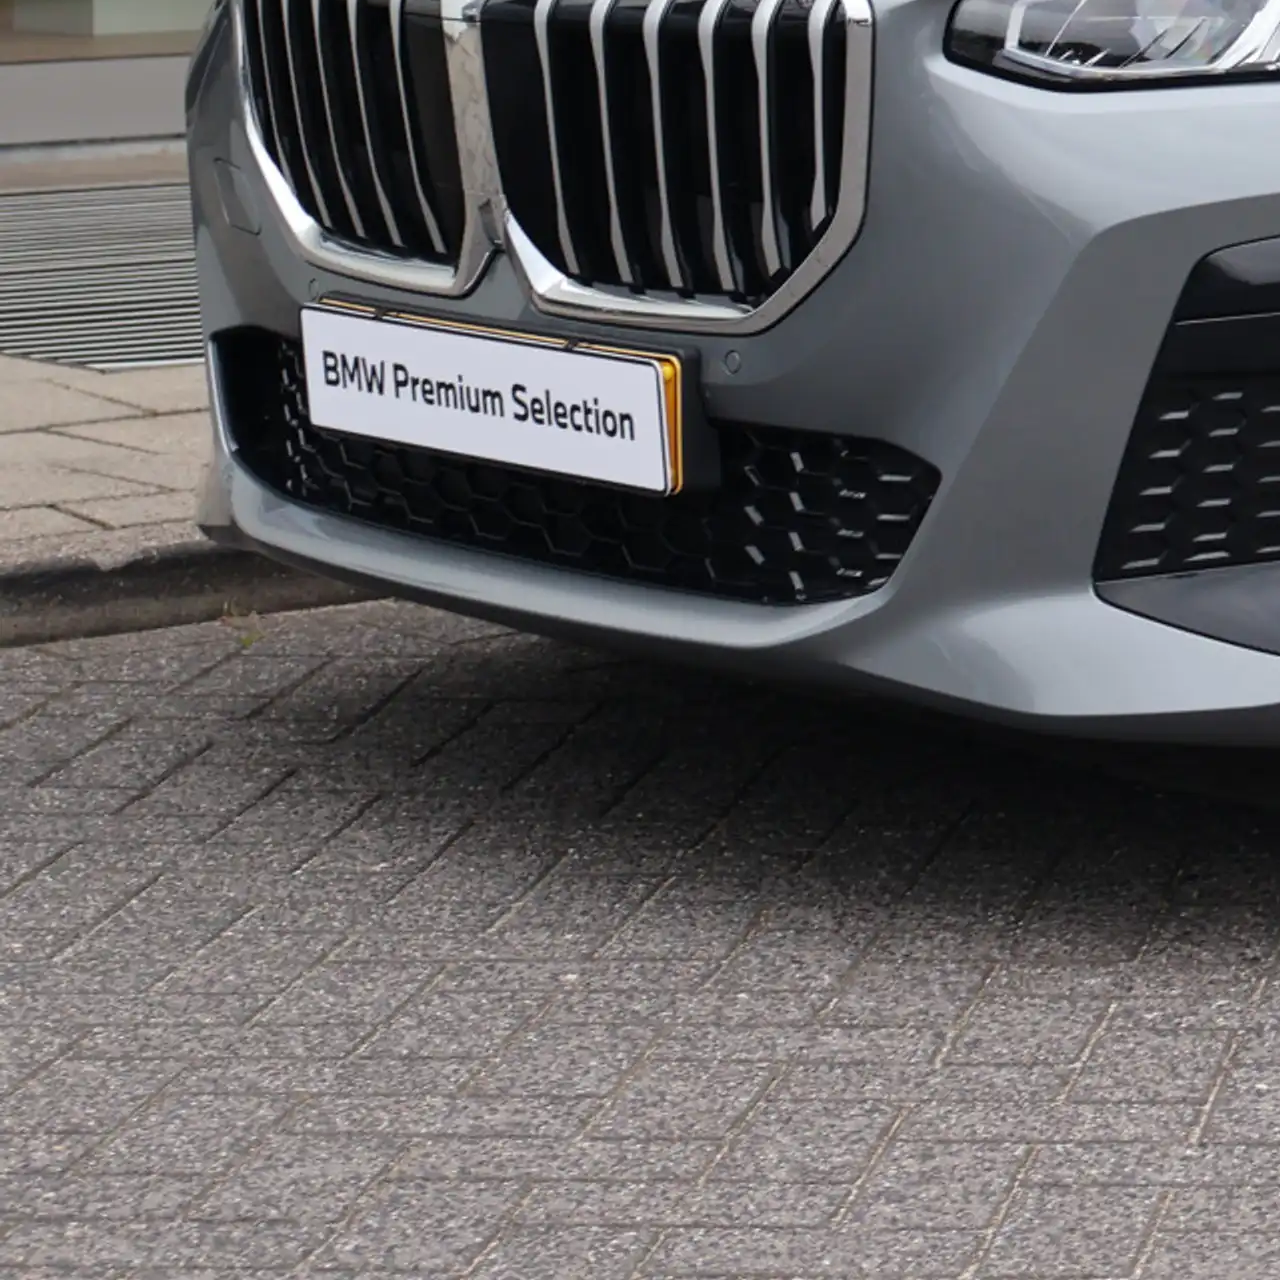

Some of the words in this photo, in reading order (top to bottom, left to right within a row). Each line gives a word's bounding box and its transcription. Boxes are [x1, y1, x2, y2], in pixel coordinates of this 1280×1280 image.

[322, 349, 387, 396] BMW
[393, 363, 505, 418] Premium
[511, 383, 637, 441] Selection
